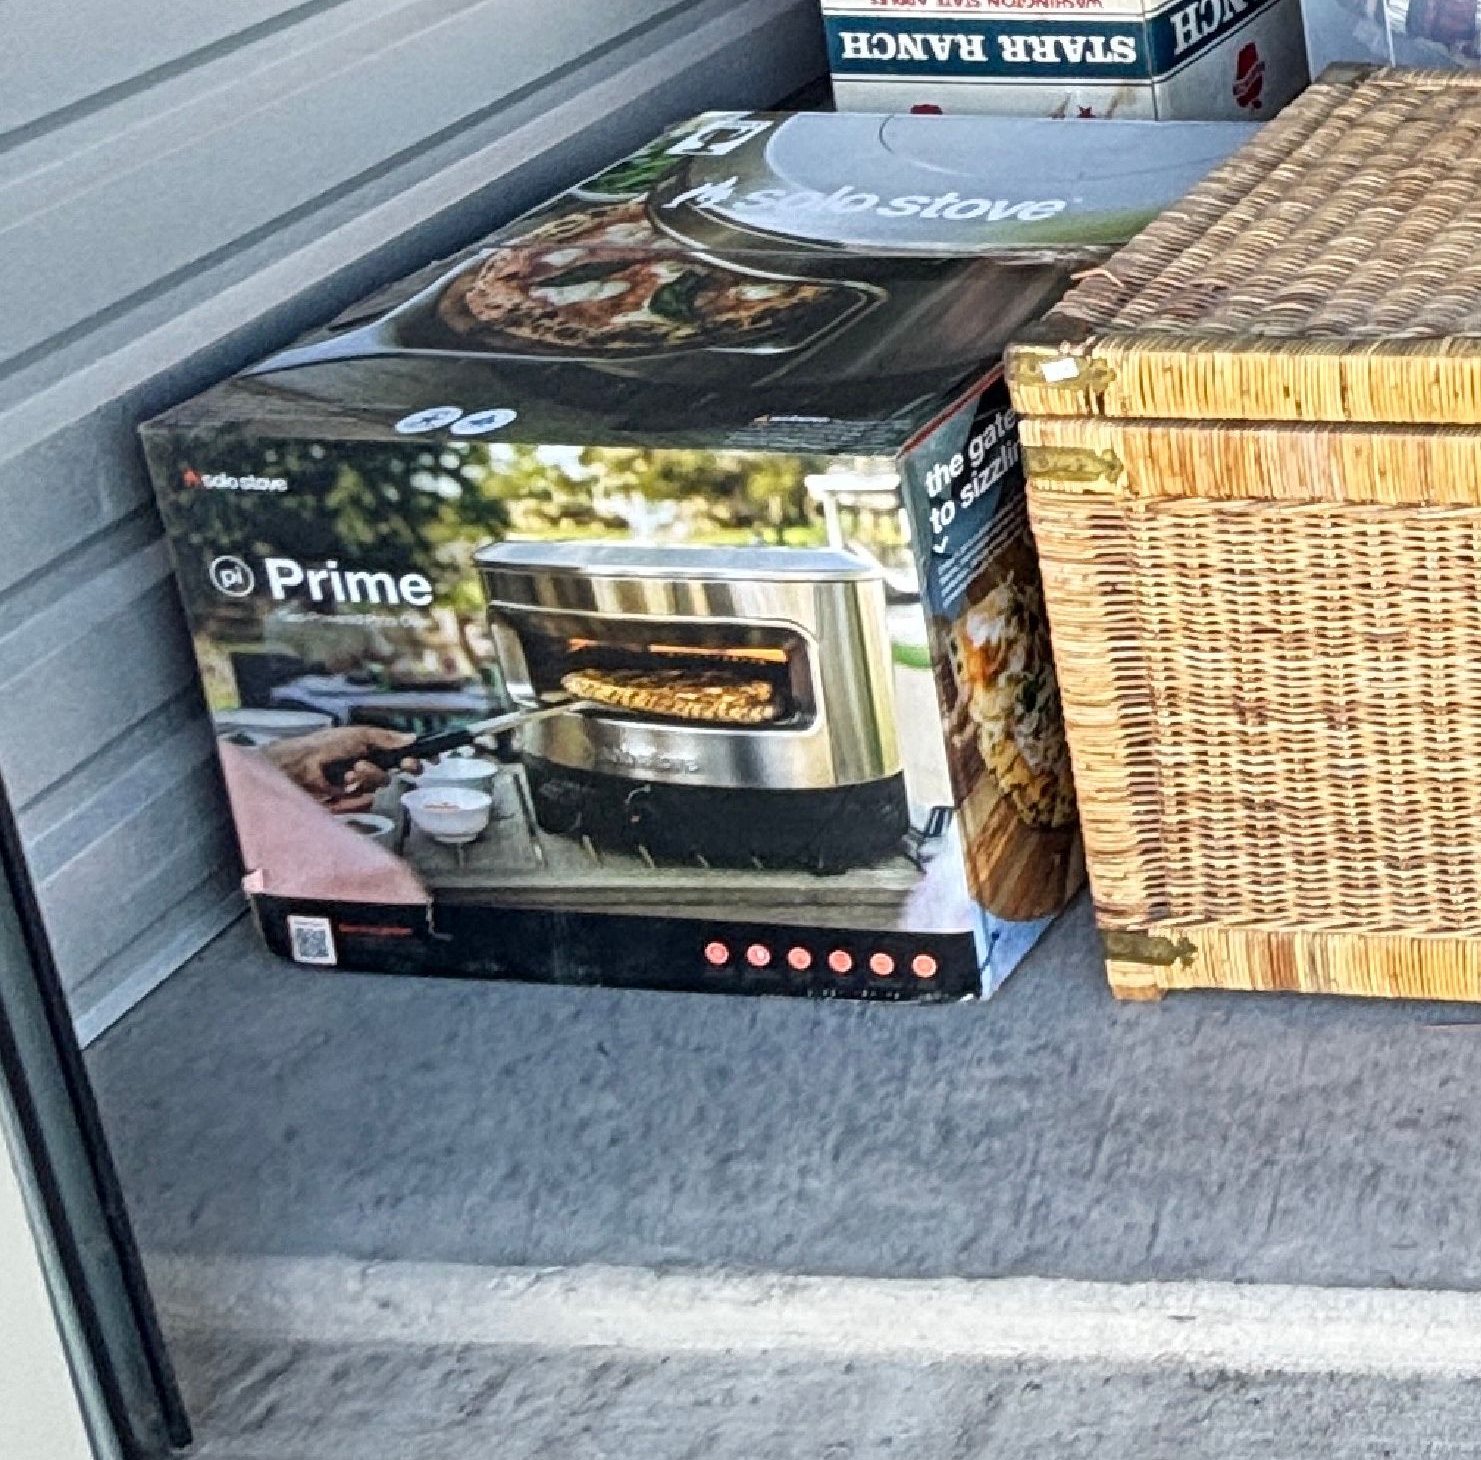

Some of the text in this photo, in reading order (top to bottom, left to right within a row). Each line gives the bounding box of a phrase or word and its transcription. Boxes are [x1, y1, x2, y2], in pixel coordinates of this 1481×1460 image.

[839, 30, 1137, 64] STARR RANCH
[732, 185, 1066, 222] solo stove
[926, 452, 964, 498] the
[929, 499, 956, 535] to
[264, 557, 433, 607] Prime
